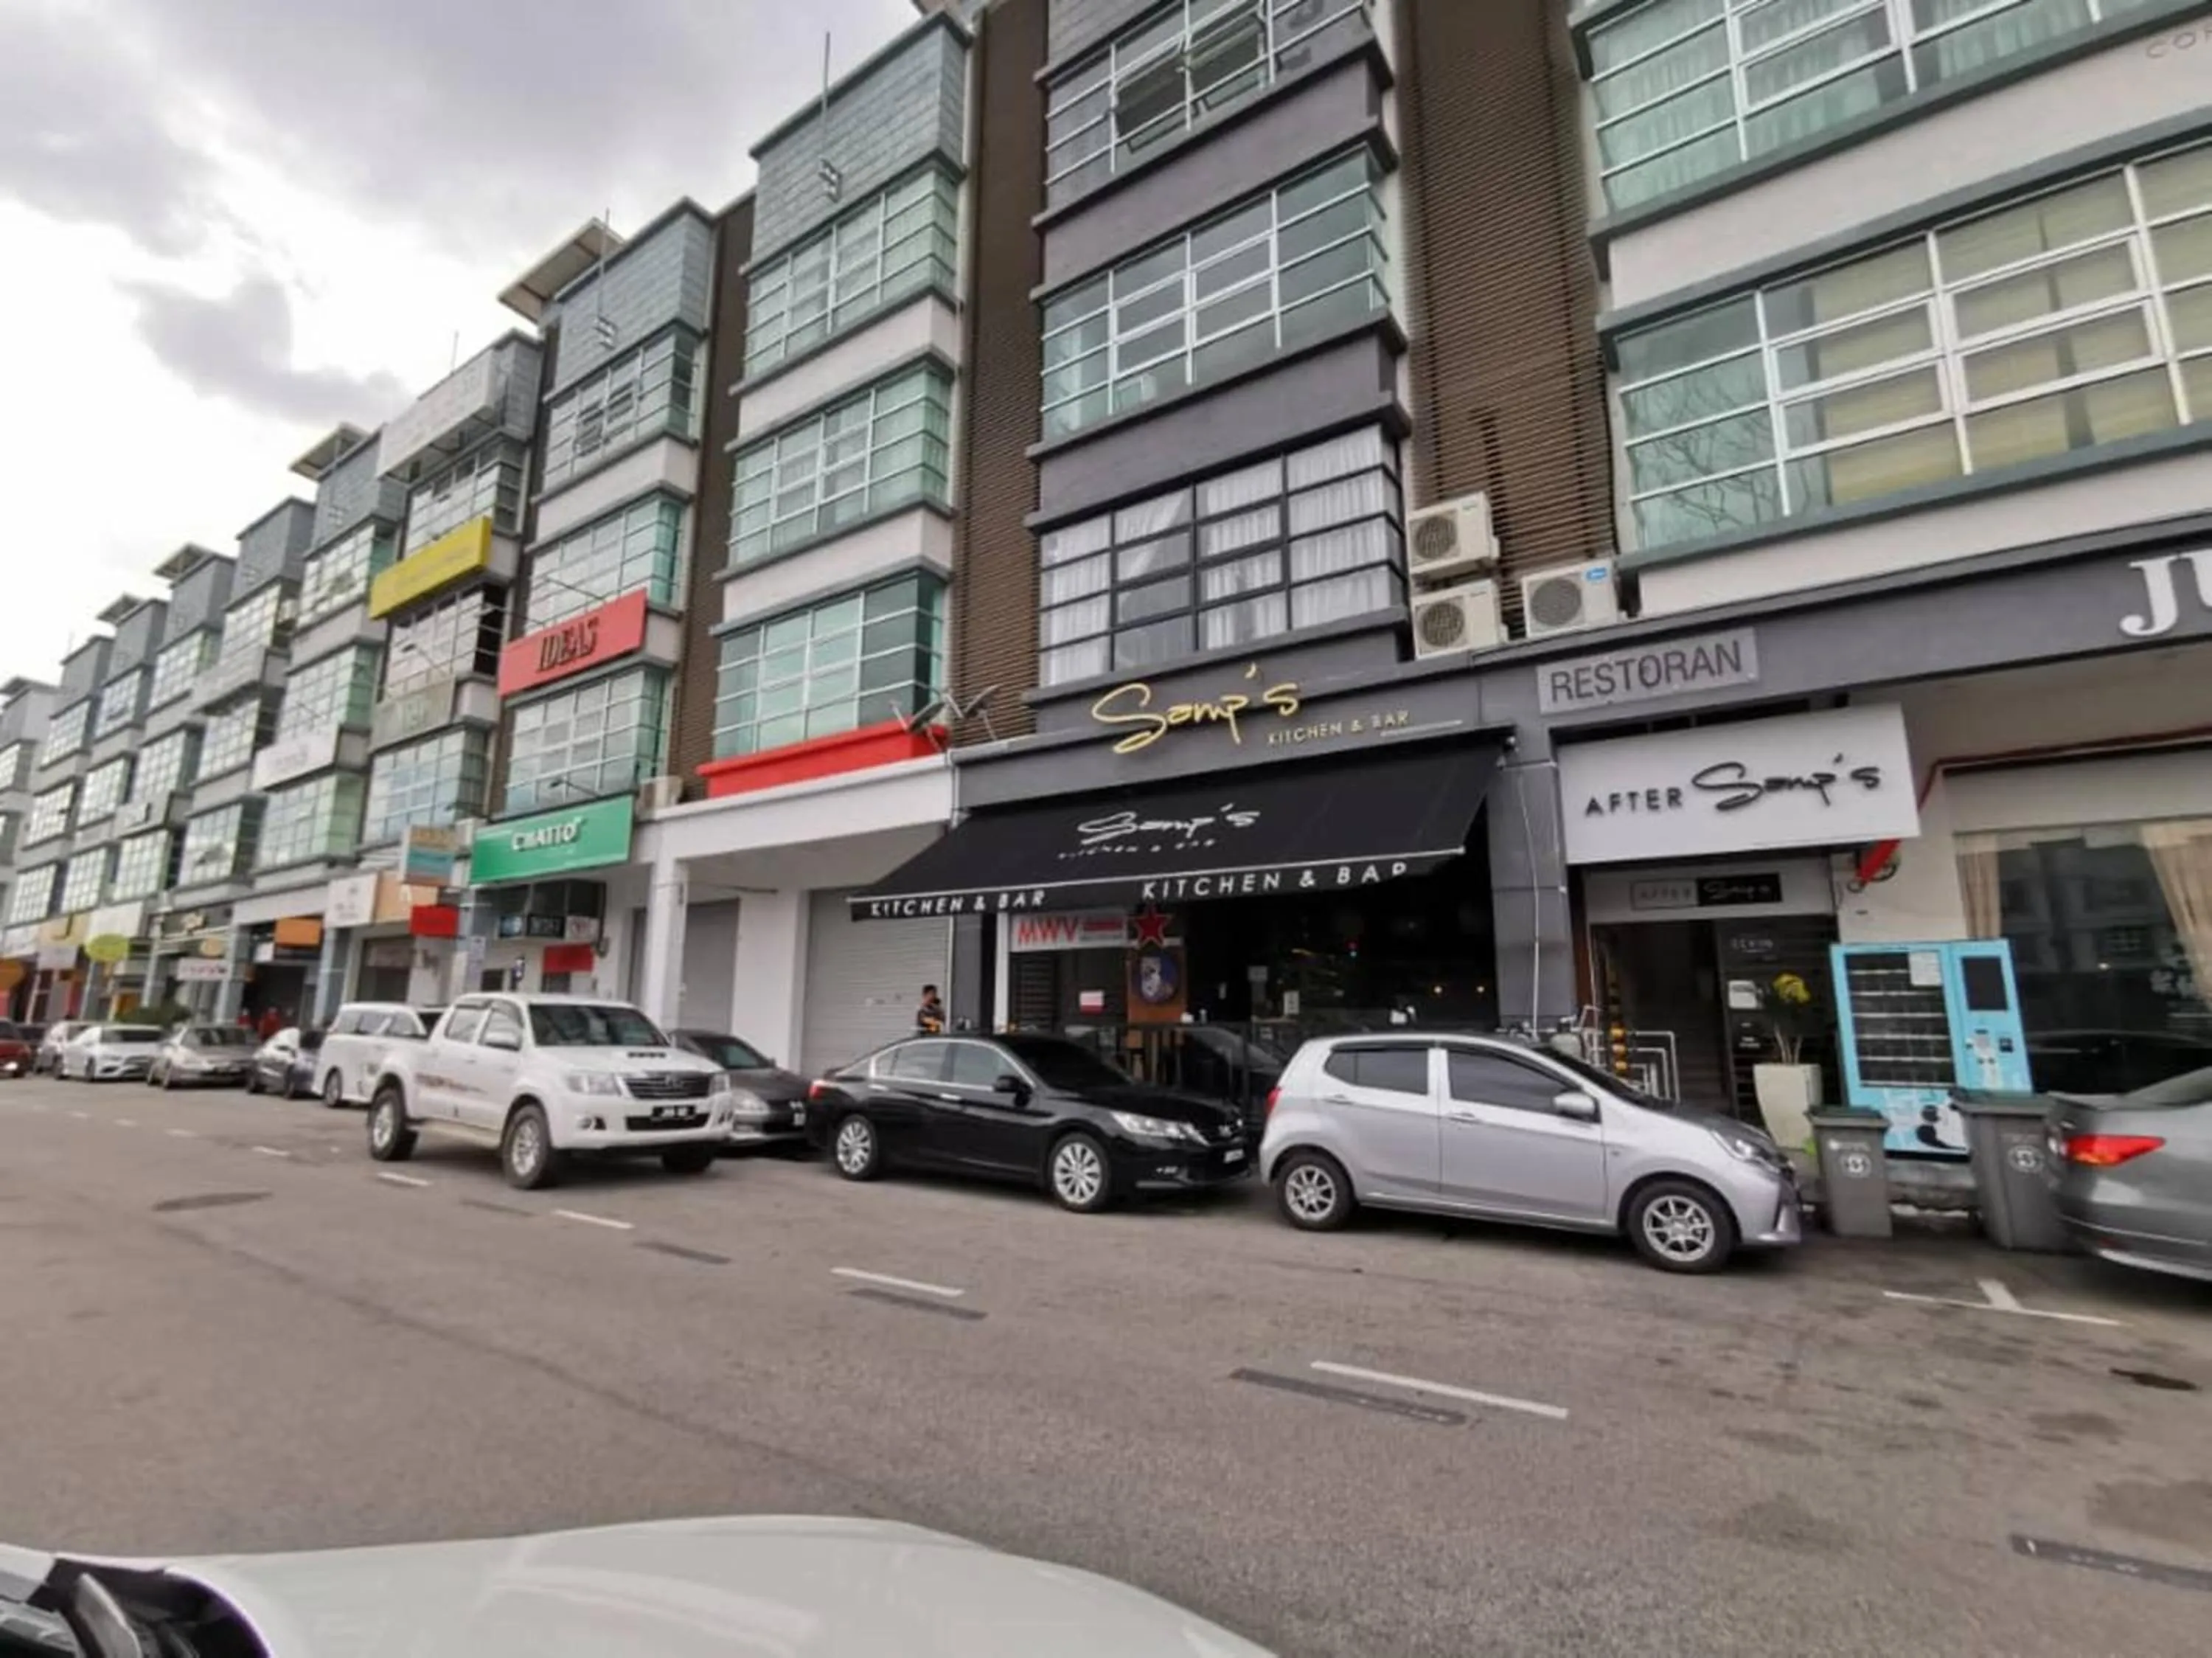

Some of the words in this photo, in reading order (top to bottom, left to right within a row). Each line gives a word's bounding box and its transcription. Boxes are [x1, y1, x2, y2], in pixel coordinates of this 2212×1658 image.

[536, 617, 599, 673] IDEAS
[1550, 639, 1742, 703] RESTORAN
[1267, 721, 1343, 745] KITCHEN
[1350, 718, 1364, 732] &
[1371, 710, 1410, 729] BAR
[1585, 786, 1684, 816] AFTER
[1142, 872, 1281, 900] KITCHEN
[1299, 870, 1315, 888] &
[870, 895, 964, 917] KITCHEN
[973, 895, 986, 911] &
[998, 889, 1046, 909] BAR
